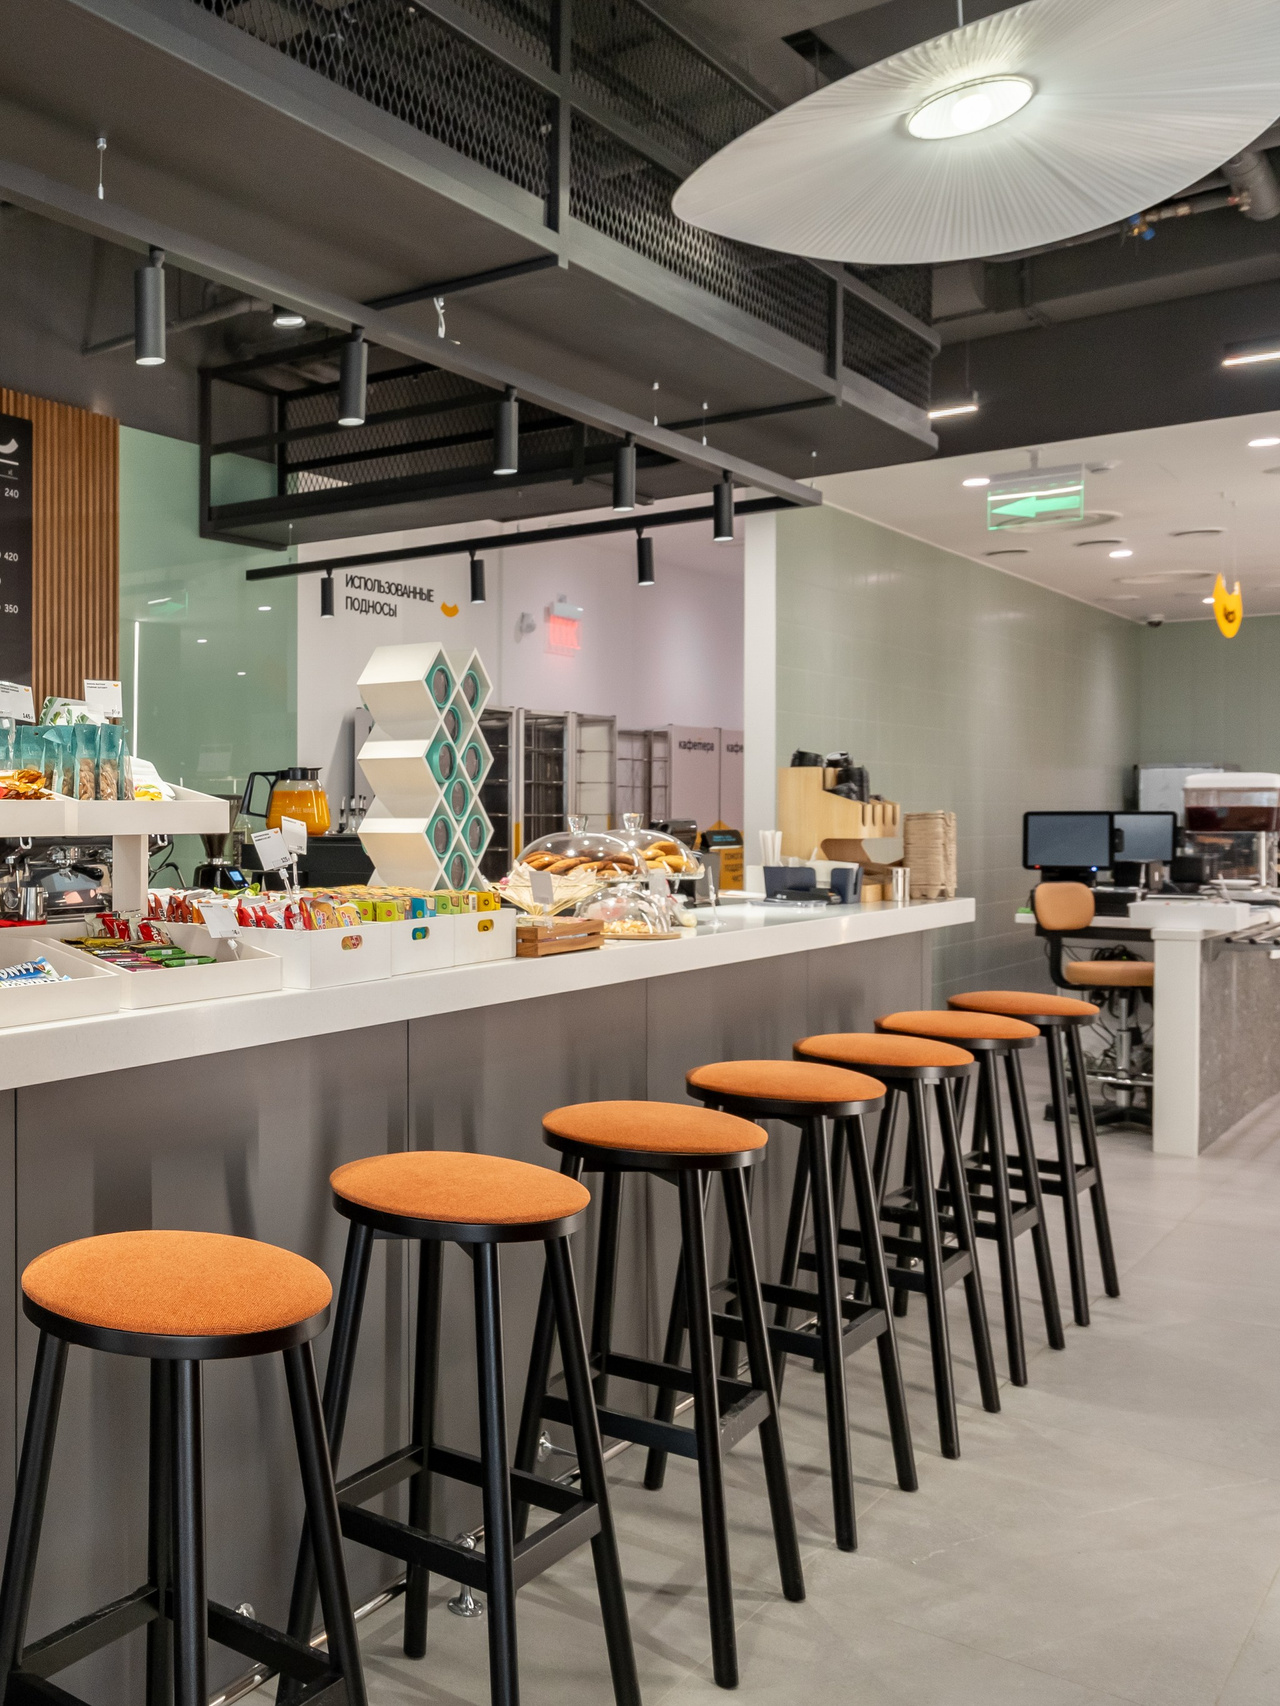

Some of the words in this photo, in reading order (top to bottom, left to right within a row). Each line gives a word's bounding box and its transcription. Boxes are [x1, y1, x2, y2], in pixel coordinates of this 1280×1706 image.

[4, 487, 19, 499] 240
[4, 551, 19, 562] 420
[345, 573, 435, 603] ИСПОЛЬЗОВАННЫЕ
[4, 603, 19, 615] 350
[345, 596, 397, 618] ПОДНОСЫ
